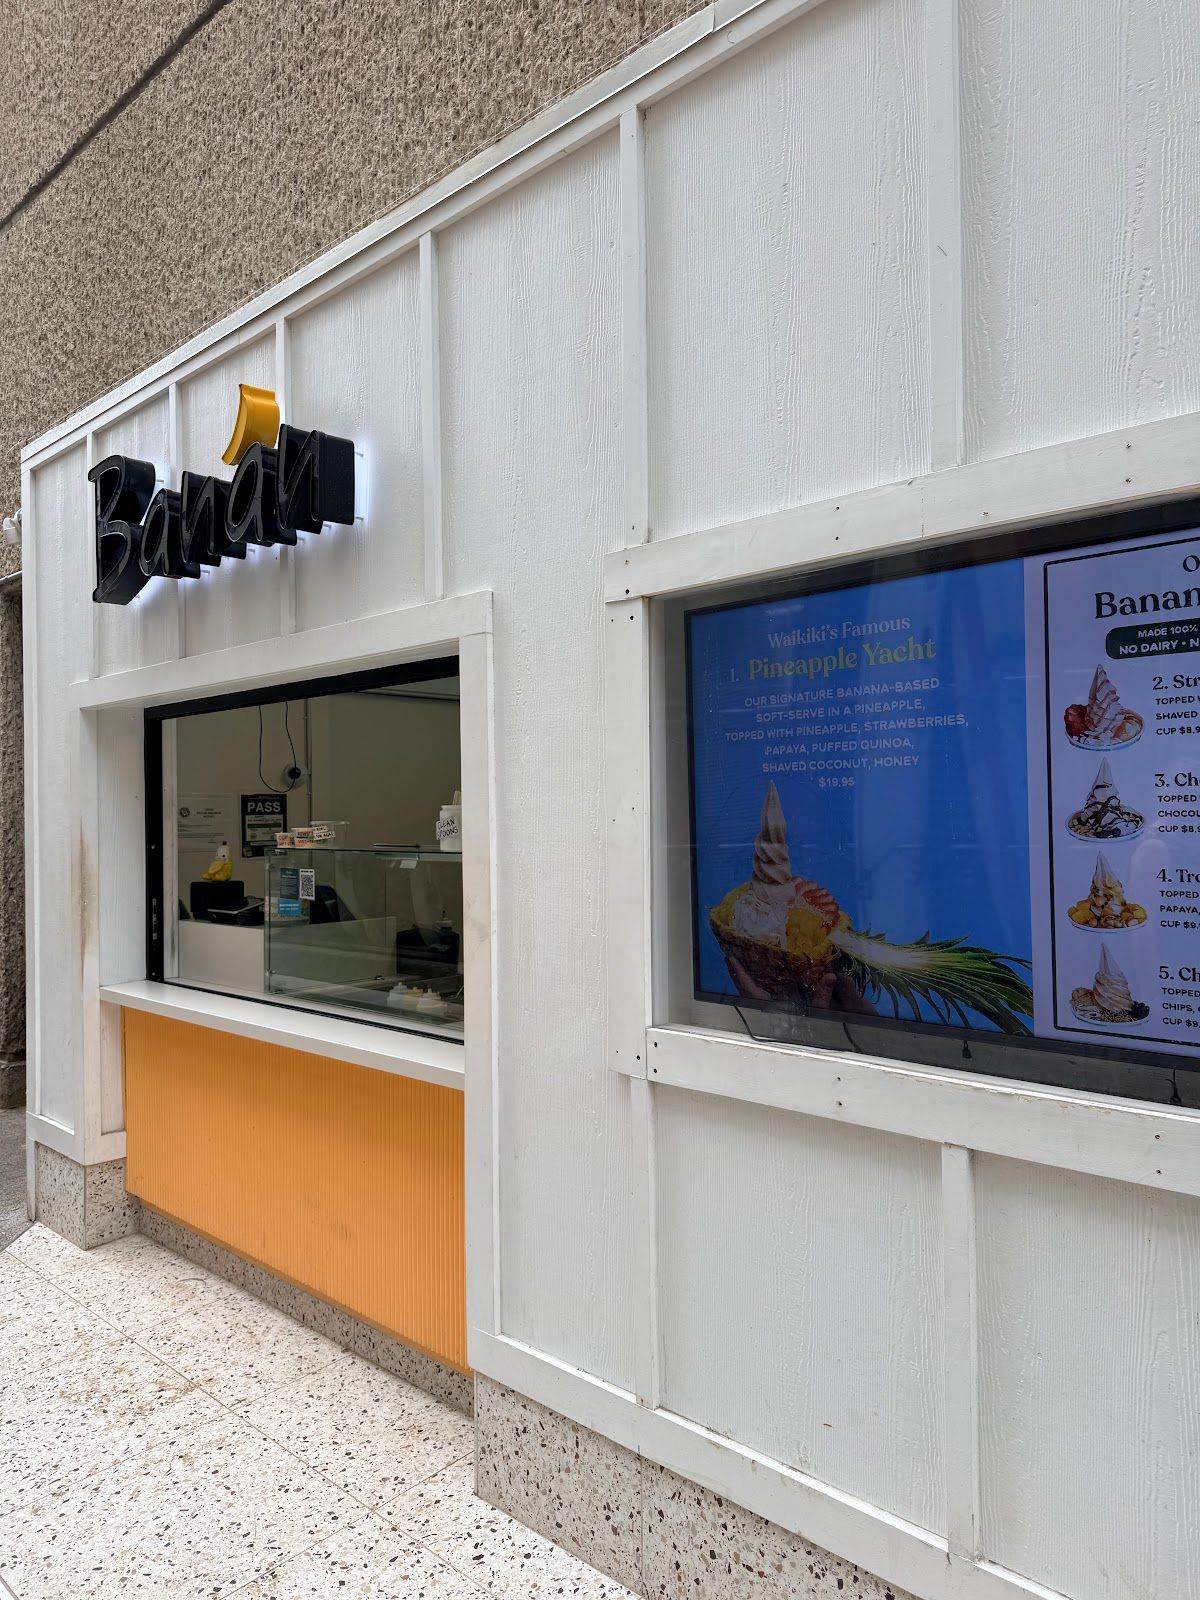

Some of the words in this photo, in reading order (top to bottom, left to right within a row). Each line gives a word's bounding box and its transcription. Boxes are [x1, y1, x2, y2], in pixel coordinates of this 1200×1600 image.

[767, 624, 838, 648] Waikiki's
[842, 617, 911, 638] Famous
[1138, 627, 1168, 639] MADE
[1170, 624, 1198, 635] 100%
[1119, 645, 1138, 655] NO
[1140, 639, 1179, 653] DAIRY
[730, 668, 740, 683] 1.
[749, 646, 857, 680] Pineapple
[862, 635, 937, 666] Yacht
[1152, 676, 1169, 691] 2.
[744, 695, 767, 707] OUR
[769, 689, 834, 705] SIGNATURE
[837, 678, 940, 698] BANANA-BASED
[1155, 695, 1195, 705] TOPPED
[756, 707, 825, 723] SOFT-SERVE
[828, 706, 840, 716] IN
[843, 704, 852, 714] A
[854, 698, 926, 714] PINEAPPLE,
[1155, 710, 1198, 720] SHAVED
[725, 730, 765, 742] TOPPED
[767, 728, 794, 739] WITH
[796, 723, 861, 737] PINEAPPLE,
[864, 714, 969, 732] STRAWBERRIES,
[1156, 727, 1177, 736] CUP
[765, 744, 810, 756] PAPAYA,
[812, 740, 857, 753] PUFFED
[860, 737, 914, 750] QUINOA,
[762, 761, 807, 773] SHAVED
[809, 757, 871, 771] COCONUT,
[874, 755, 920, 767] HONEY
[818, 777, 855, 788] $19.95
[1154, 773, 1170, 788] 3.
[1174, 771, 1200, 787] Ch
[1157, 794, 1198, 803] TOPPED
[247, 802, 281, 813] PASS
[1158, 825, 1179, 833] CUP
[1156, 868, 1173, 883] 4.
[1159, 890, 1200, 899] TOPPED
[1160, 919, 1181, 928] CUP
[1158, 965, 1175, 980] 5.
[1161, 987, 1200, 998] TOPPED
[1162, 1002, 1195, 1014] CHIPS,
[1162, 1017, 1183, 1026] CUP
